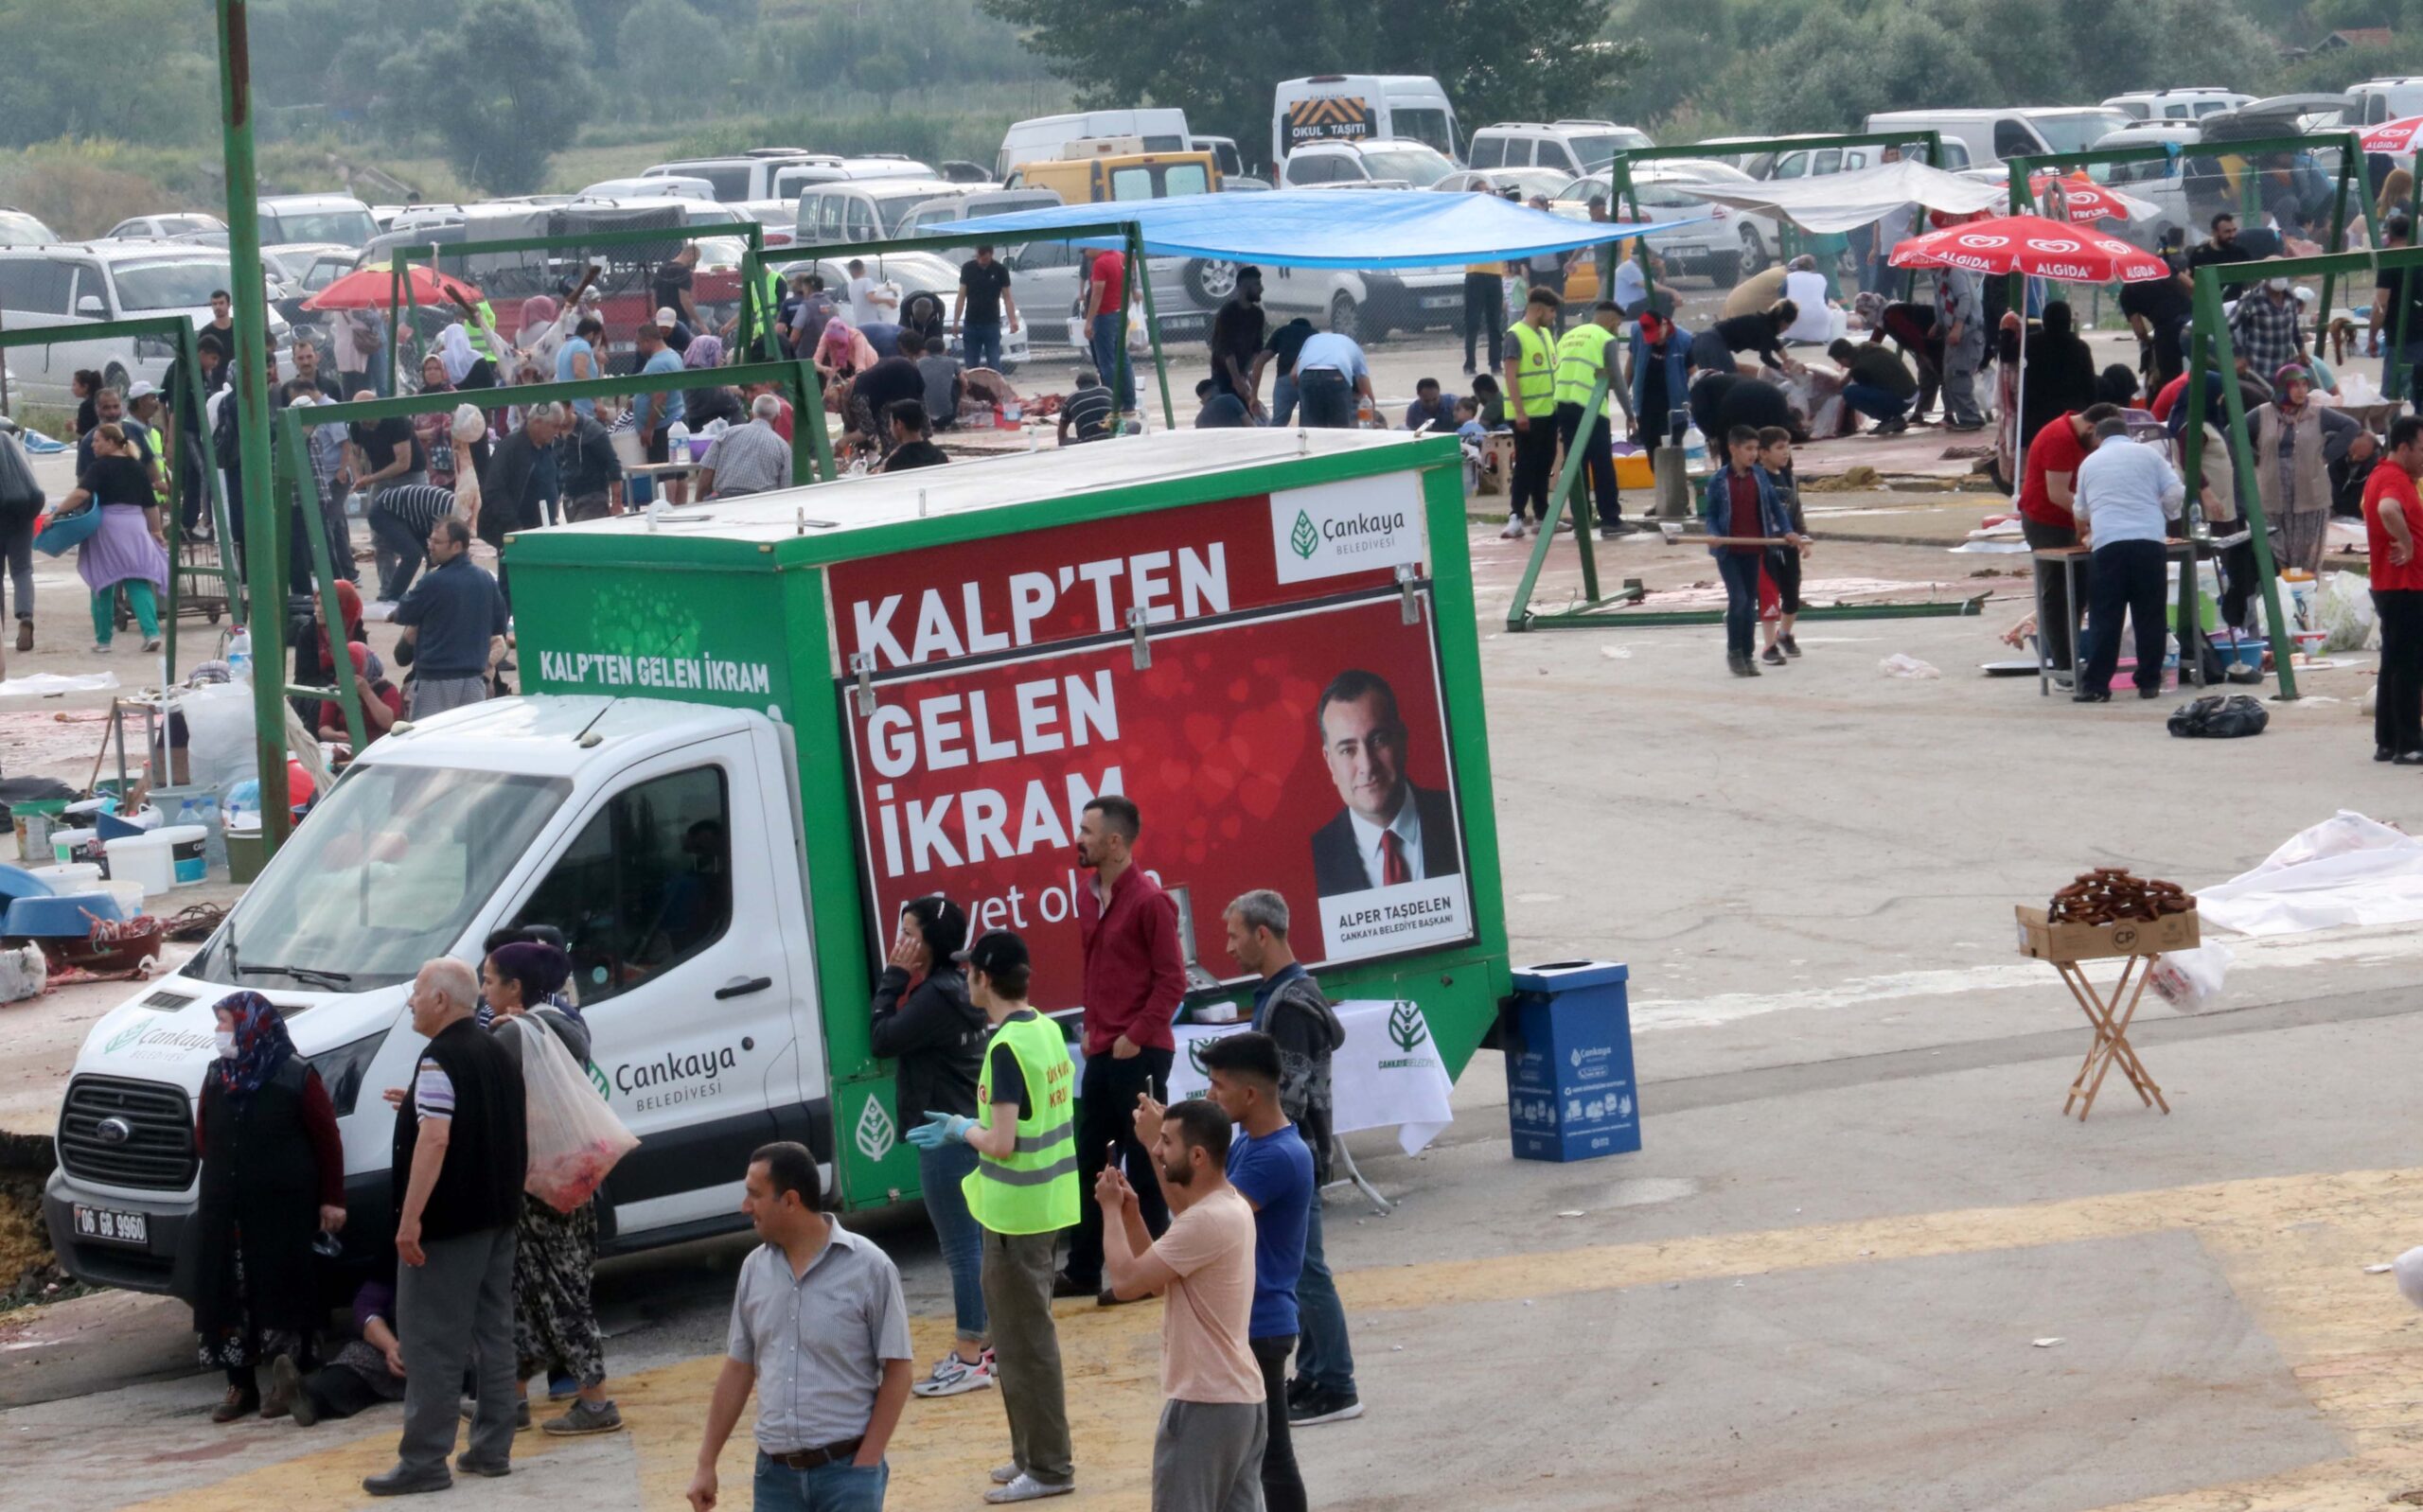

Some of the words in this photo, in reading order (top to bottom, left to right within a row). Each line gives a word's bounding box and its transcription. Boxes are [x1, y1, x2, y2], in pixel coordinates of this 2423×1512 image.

[1292, 126, 1323, 137] OKUL
[1330, 123, 1366, 136] TAŞITI
[1322, 511, 1406, 542] Çankaya
[1336, 536, 1396, 555] BELEDİYESİ
[635, 656, 701, 690] GELEN
[703, 651, 771, 694] İKRAM
[866, 669, 1120, 778] GELEN
[876, 765, 1124, 878] İKRAM
[1339, 908, 1382, 928] ALPER
[1384, 896, 1452, 920] TAŞDELEN
[1340, 930, 1378, 942] ÇANKAYA
[1379, 920, 1418, 935] BELEDİYE
[1418, 914, 1454, 928] BAŞKANI
[2114, 931, 2135, 944] CP
[615, 1046, 736, 1096] Çankaya
[636, 1078, 722, 1113] BELEDİYESİ
[81, 1208, 95, 1234] 06
[99, 1211, 114, 1237] GB
[115, 1214, 145, 1240] 9960
